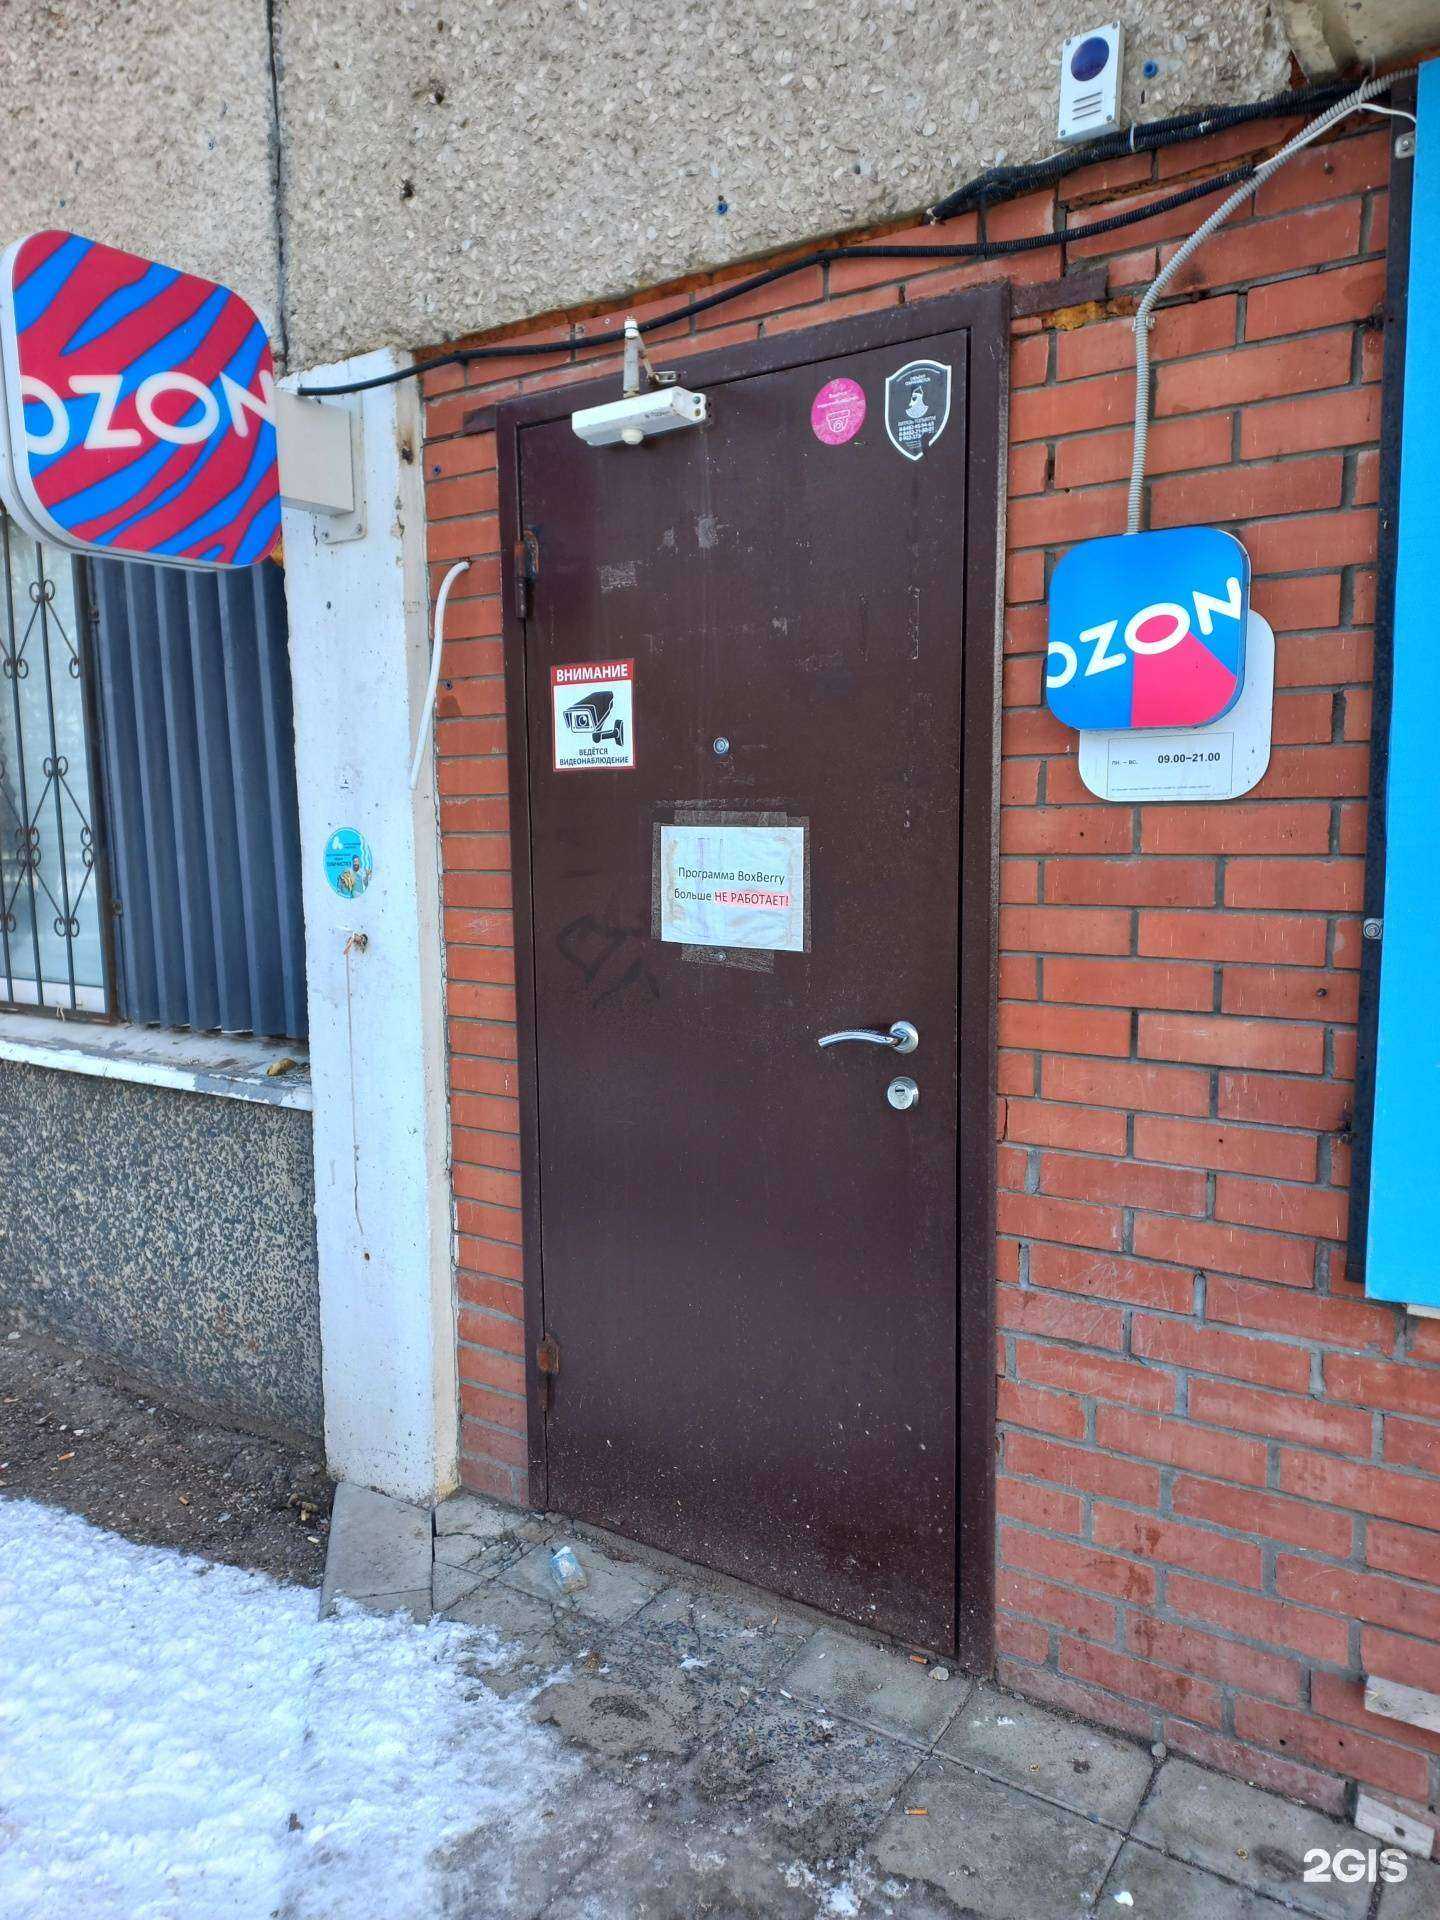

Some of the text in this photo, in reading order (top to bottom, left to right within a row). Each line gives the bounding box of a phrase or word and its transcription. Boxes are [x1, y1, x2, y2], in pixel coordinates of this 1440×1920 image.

[556, 663, 628, 682] ВНИМАНИЕ
[578, 747, 608, 757] ВЕДЁТСЯ
[559, 756, 629, 767] ВИДЕОНАБЛЮДЕНИЕ
[678, 867, 785, 885] Программа BoxBerry
[674, 888, 789, 907] больше НЕ РАБОТАЕТ!
